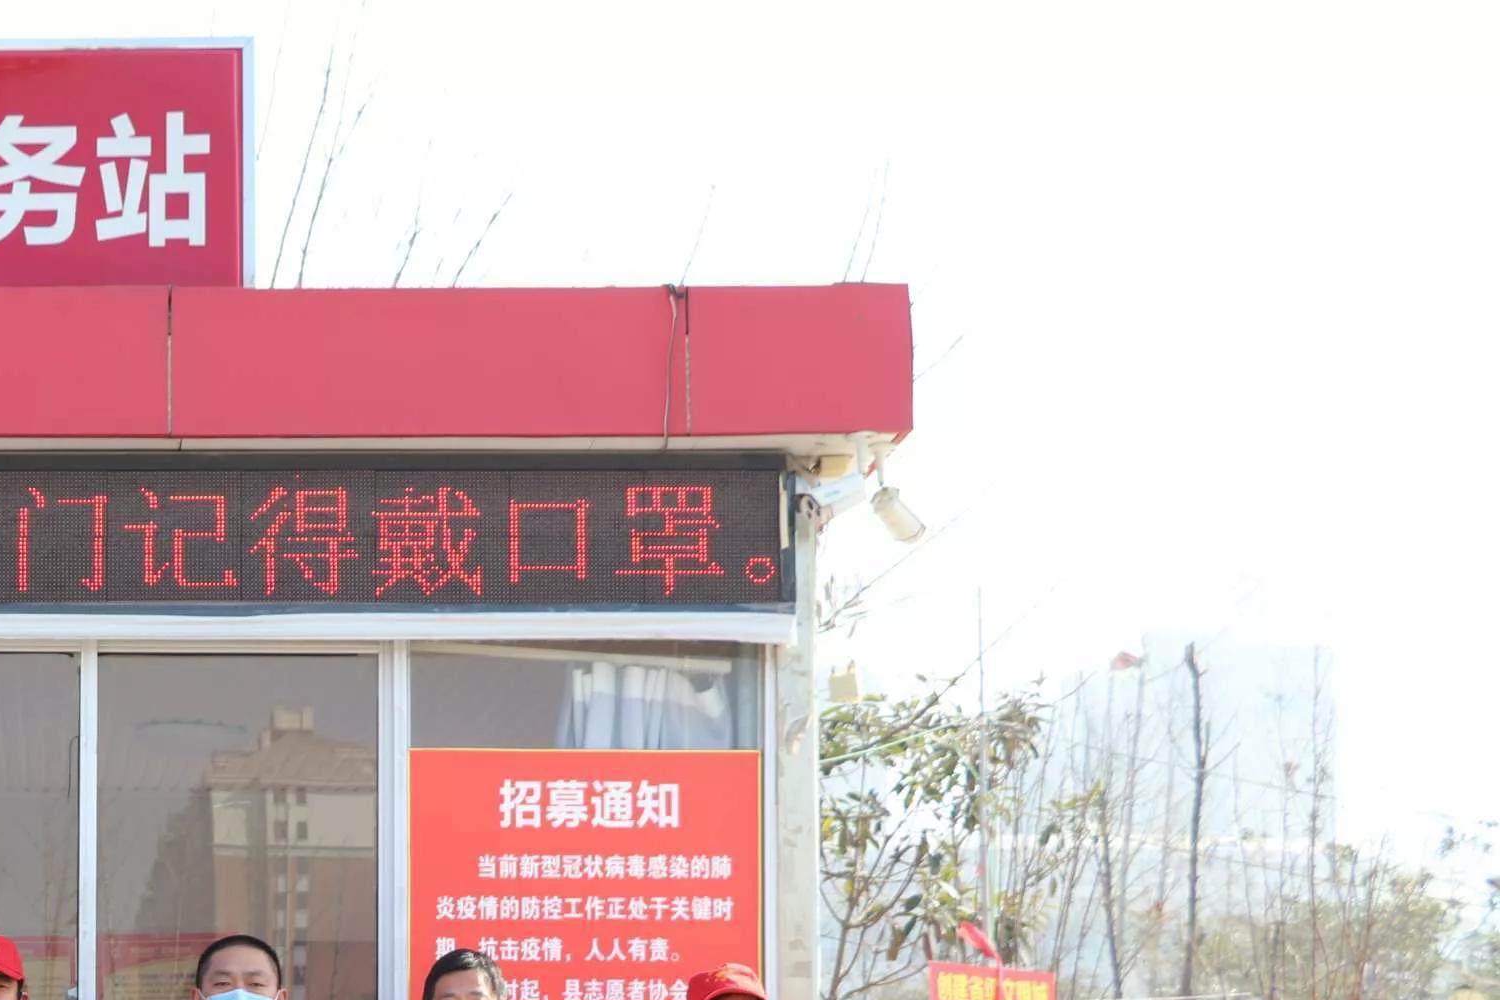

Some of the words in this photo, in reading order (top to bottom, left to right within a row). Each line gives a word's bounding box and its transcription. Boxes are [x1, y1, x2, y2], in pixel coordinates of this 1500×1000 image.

[499, 779, 680, 829] 招募通知
[477, 854, 732, 880] 当前新型冠状病毒感染的肺
[435, 895, 734, 922] 炎疫情的防控工作正处于关键时
[435, 936, 681, 962] 期抗击疫情，人人有责。
